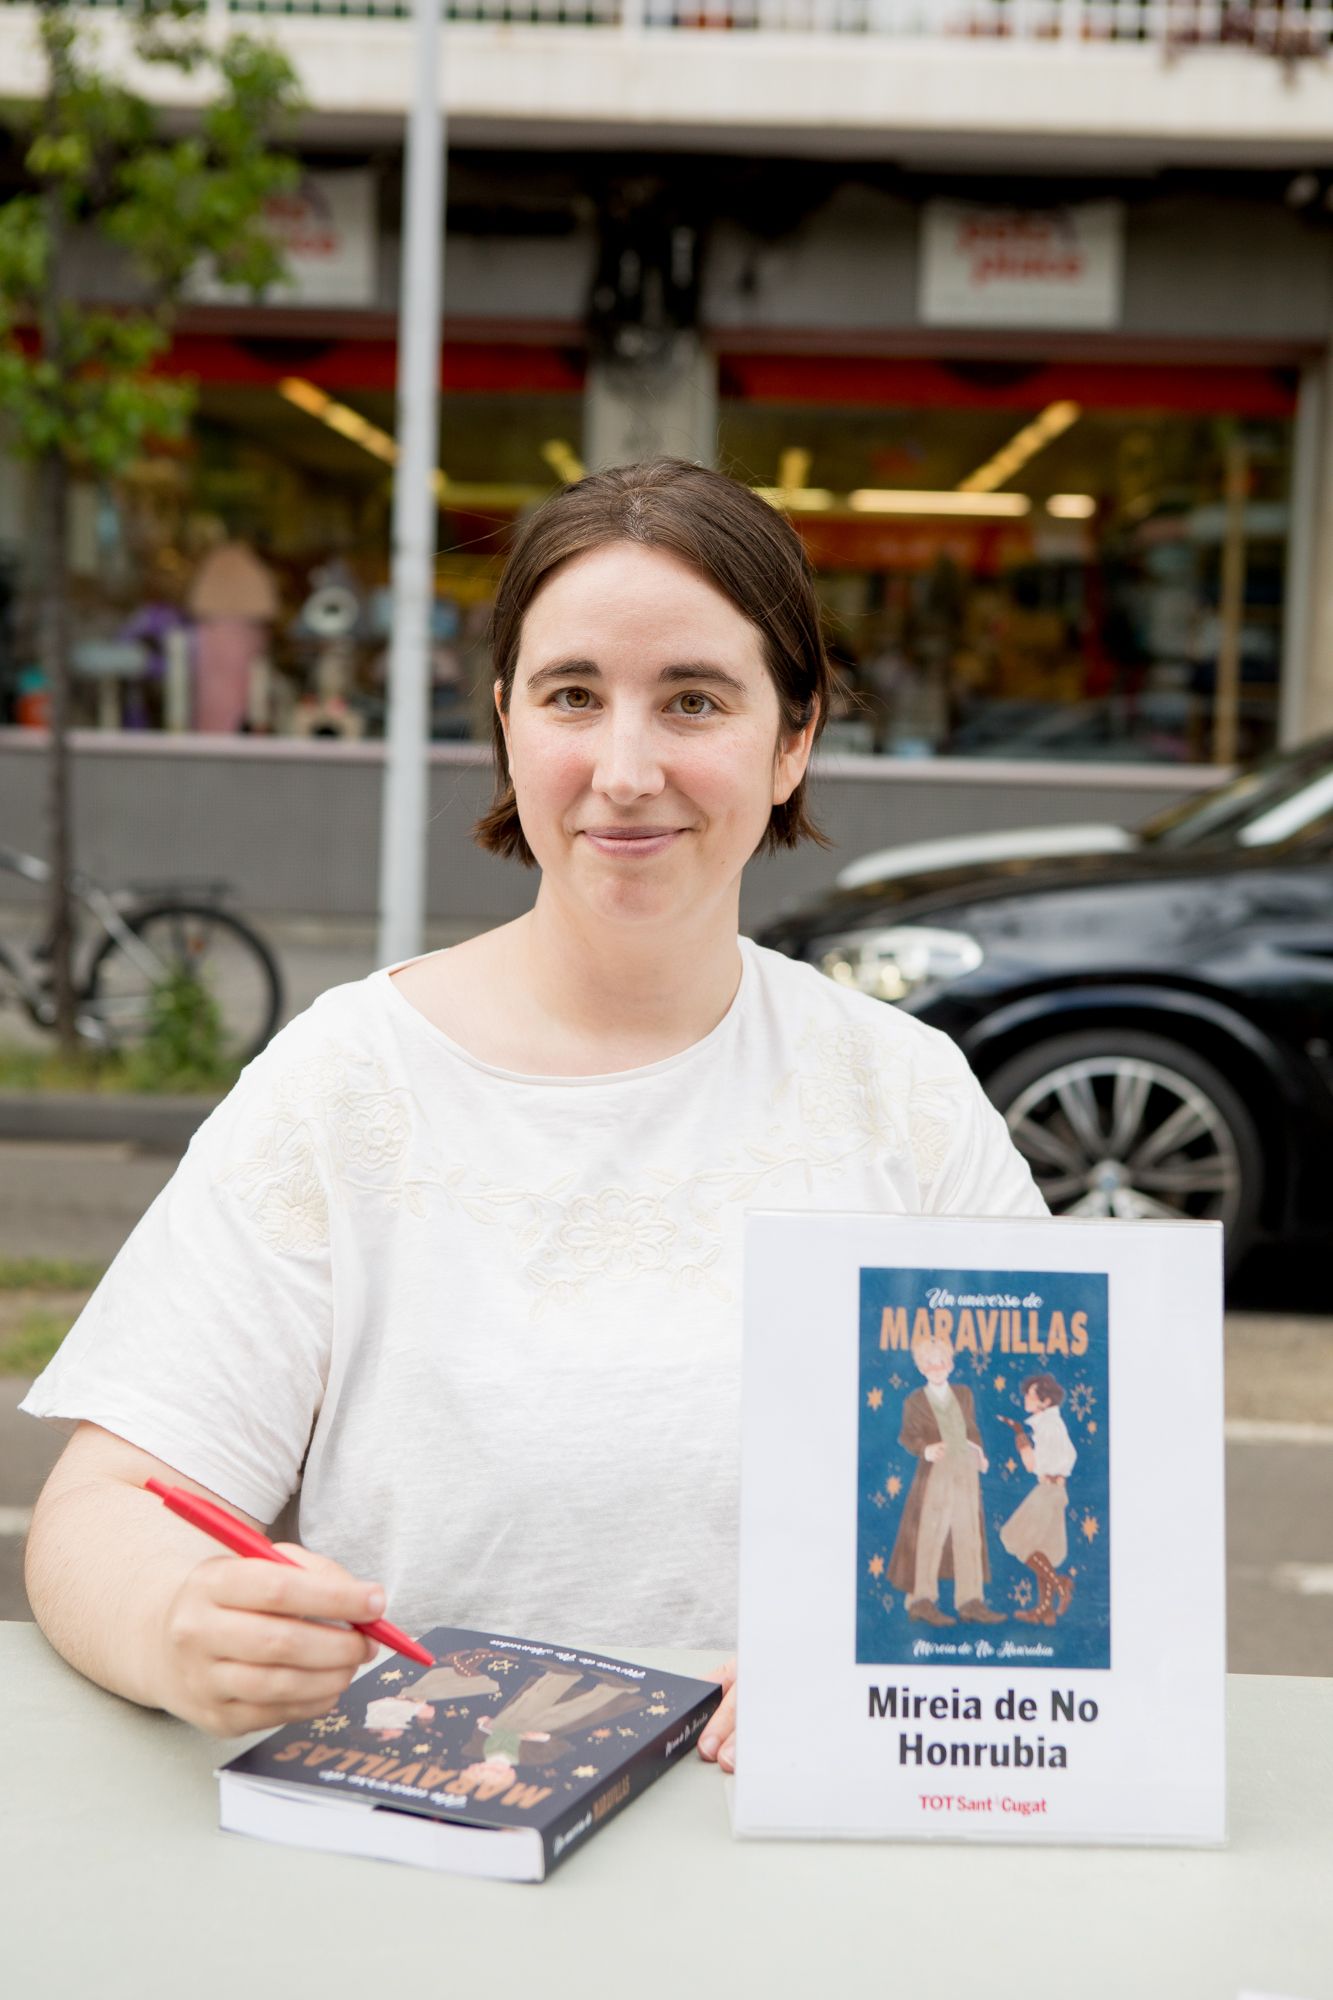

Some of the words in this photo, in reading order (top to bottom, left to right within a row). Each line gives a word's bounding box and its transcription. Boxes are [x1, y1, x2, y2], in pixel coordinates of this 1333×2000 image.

[925, 1287, 956, 1309] Un
[957, 1292, 1021, 1308] universo
[1022, 1292, 1044, 1308] de
[879, 1305, 1090, 1357] MARAVILLAS
[868, 1685, 983, 1720] Mireia
[994, 1688, 1038, 1721] de
[1050, 1689, 1099, 1723] No
[898, 1732, 1068, 1769] Honrubia
[272, 1740, 553, 1810] MARAVILLAS
[919, 1795, 954, 1811] TOT
[956, 1796, 992, 1812] Sant
[1001, 1798, 1048, 1816] Cugat
